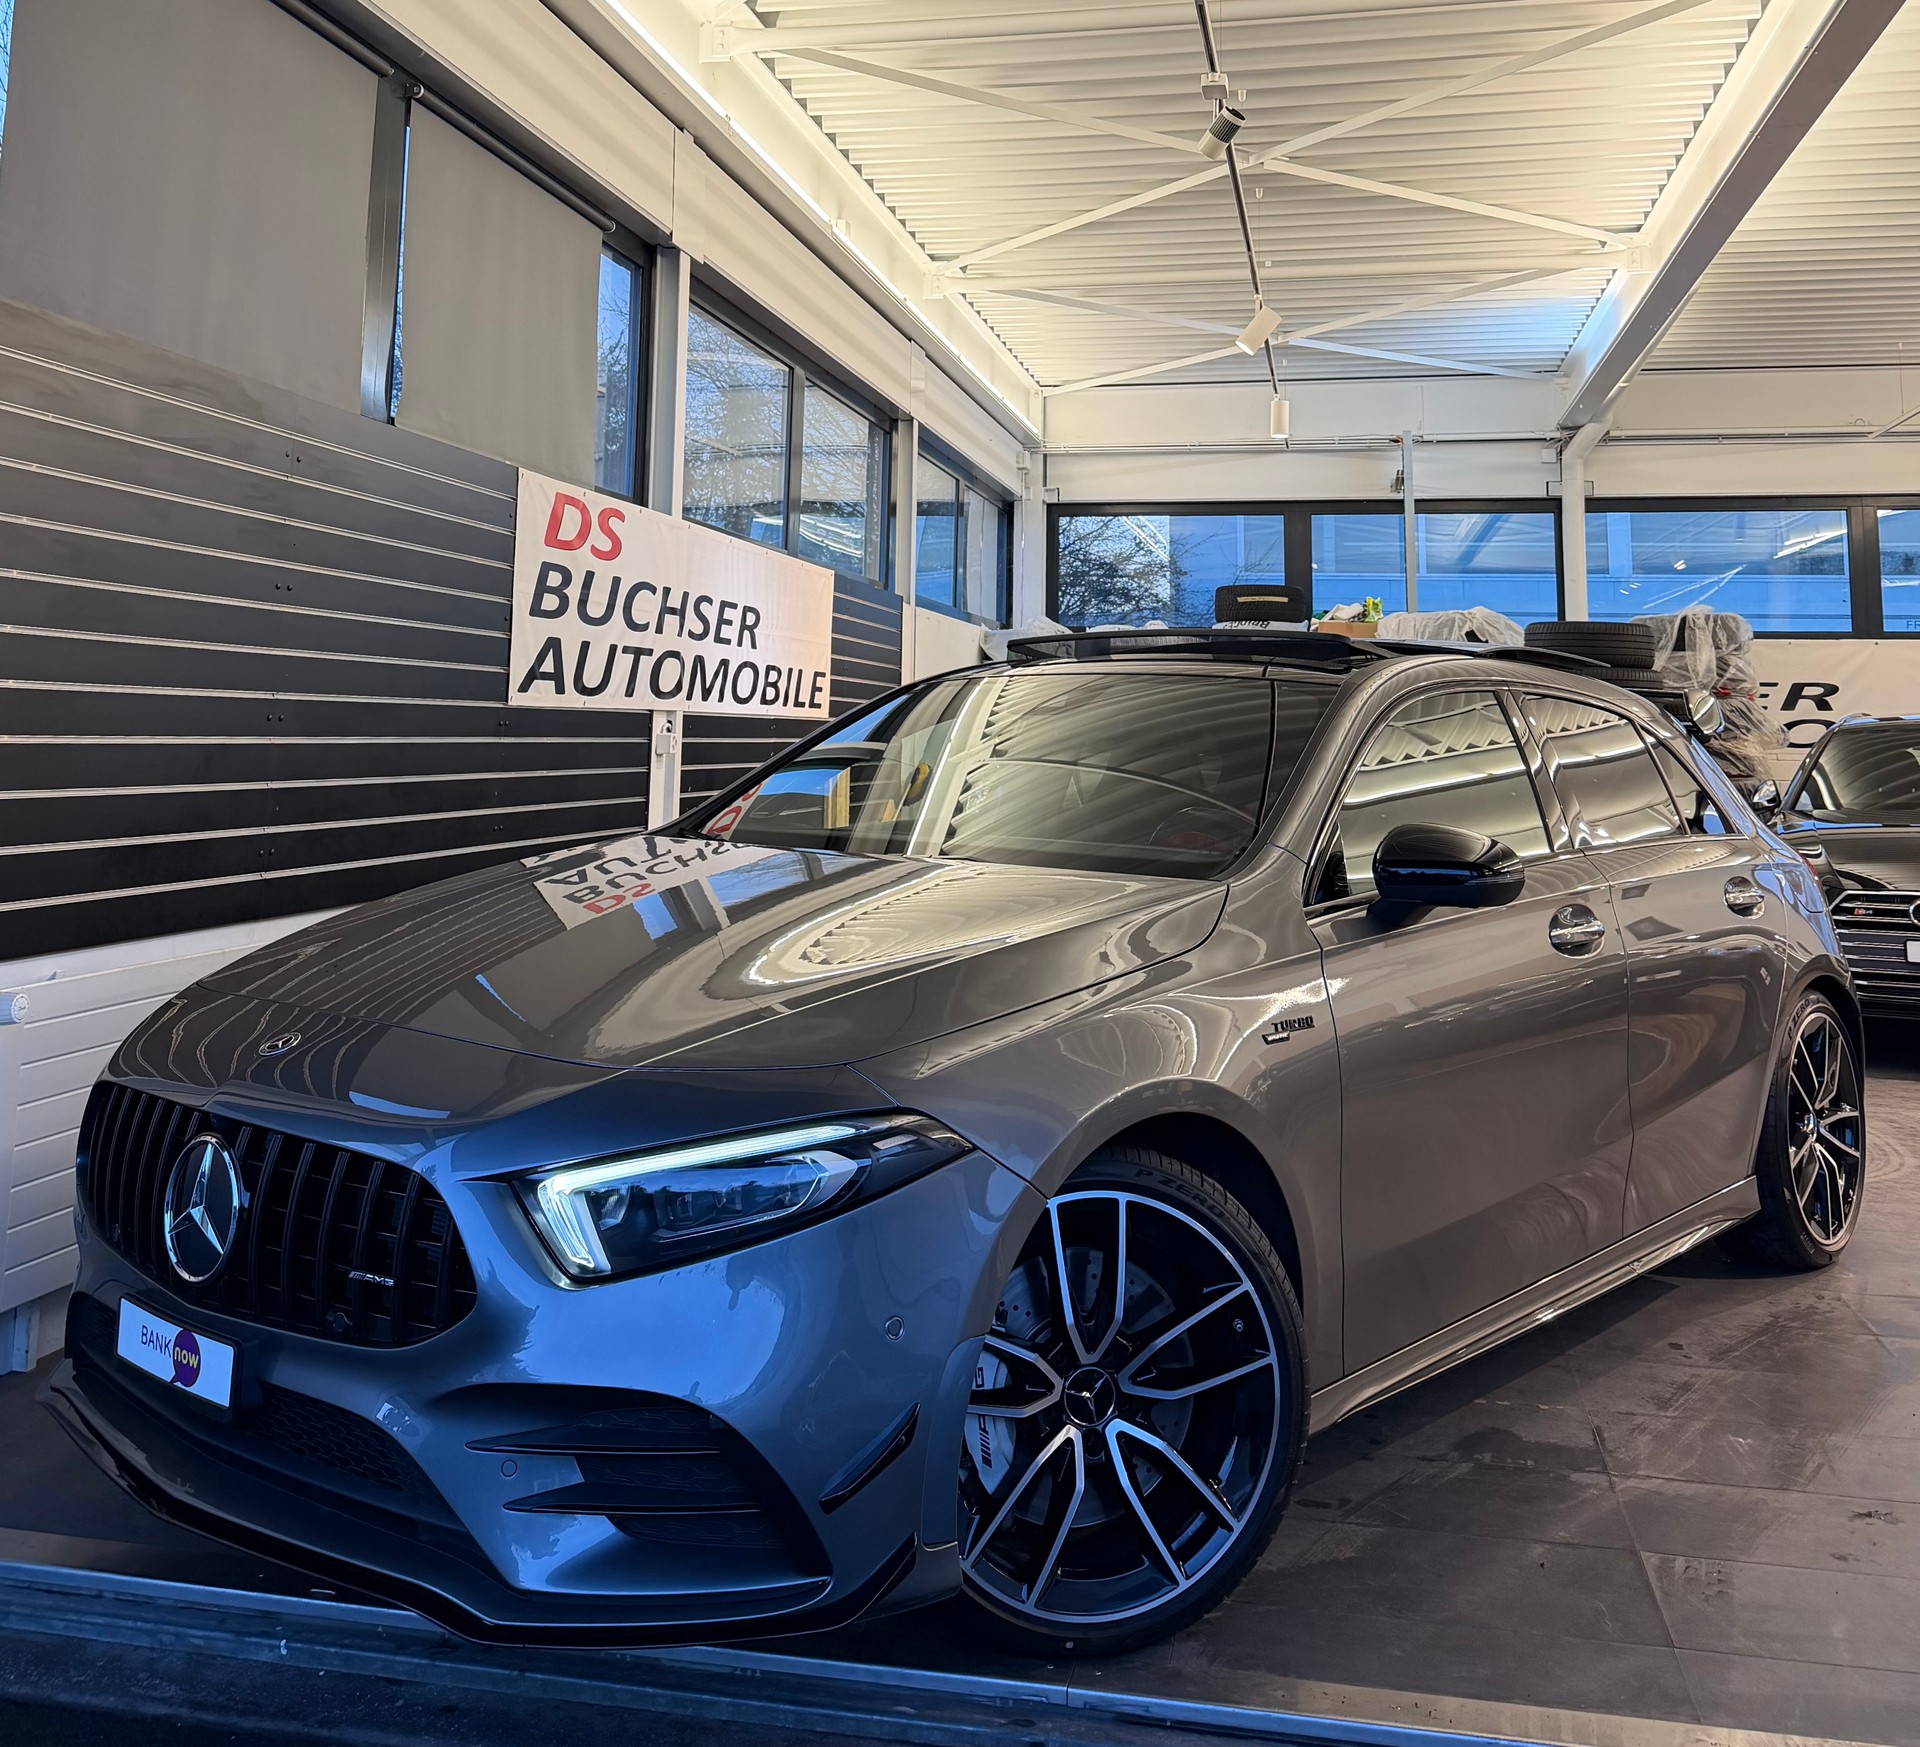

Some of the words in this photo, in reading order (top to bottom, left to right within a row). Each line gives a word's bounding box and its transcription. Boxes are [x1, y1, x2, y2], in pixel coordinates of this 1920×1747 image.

[544, 491, 626, 562] DS
[528, 560, 761, 651] BUCHSER
[517, 635, 827, 709] AUTOMOBILE
[1271, 1015, 1314, 1032] TURBO
[1156, 1174, 1227, 1219] ZERO
[140, 1324, 172, 1358] BANK
[174, 1346, 200, 1369] now
